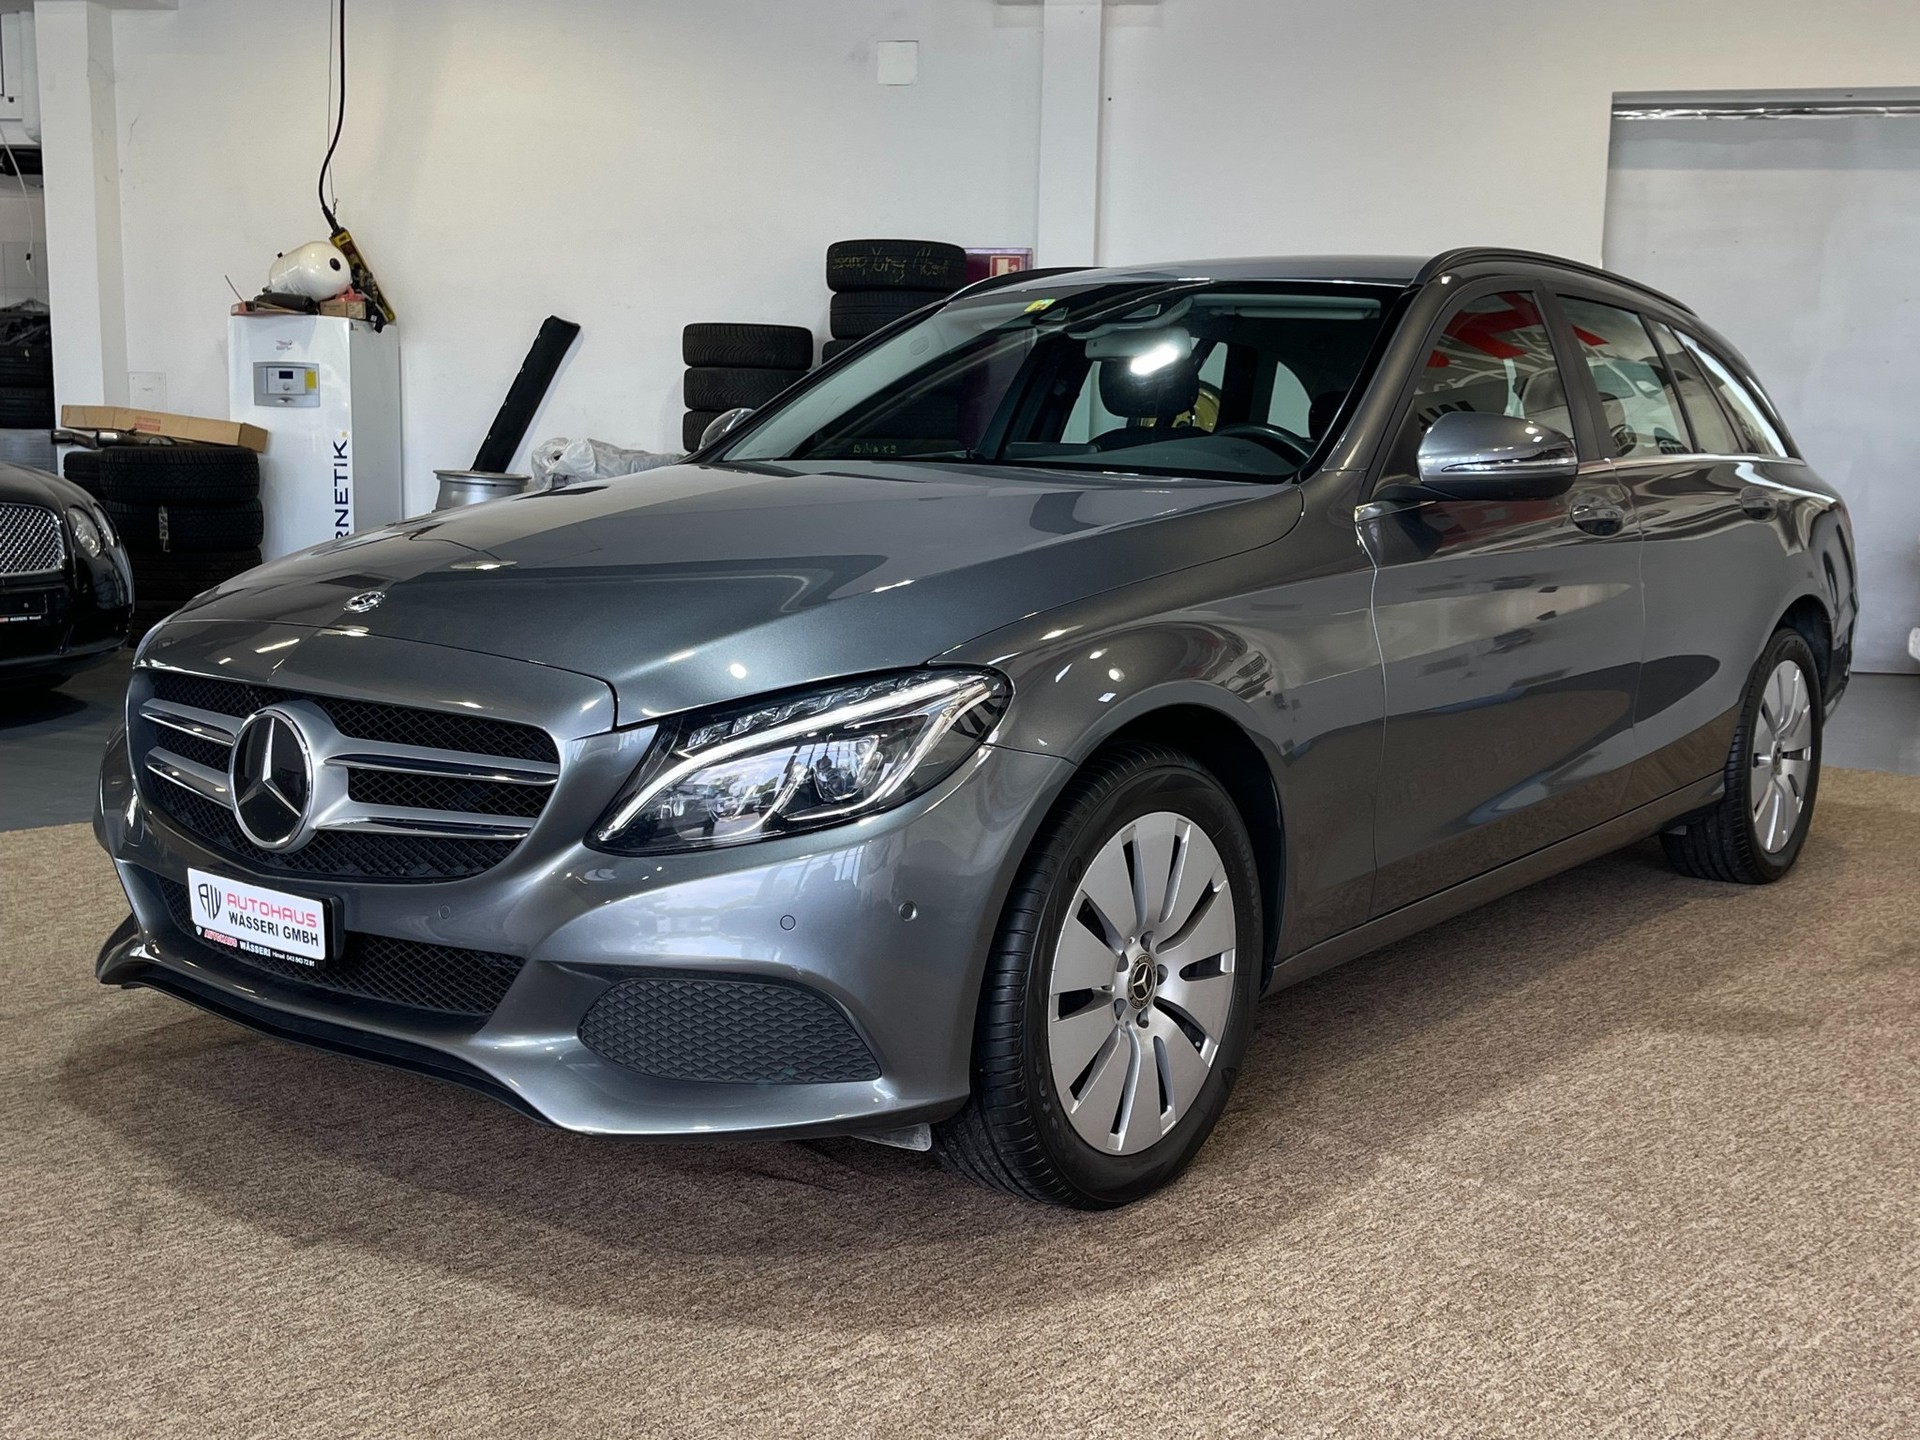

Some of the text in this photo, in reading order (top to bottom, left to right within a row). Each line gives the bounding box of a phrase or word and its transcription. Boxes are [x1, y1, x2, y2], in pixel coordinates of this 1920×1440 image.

[226, 893, 318, 929] AUTOHAUS
[228, 910, 320, 947] WÄSSERI GMBH
